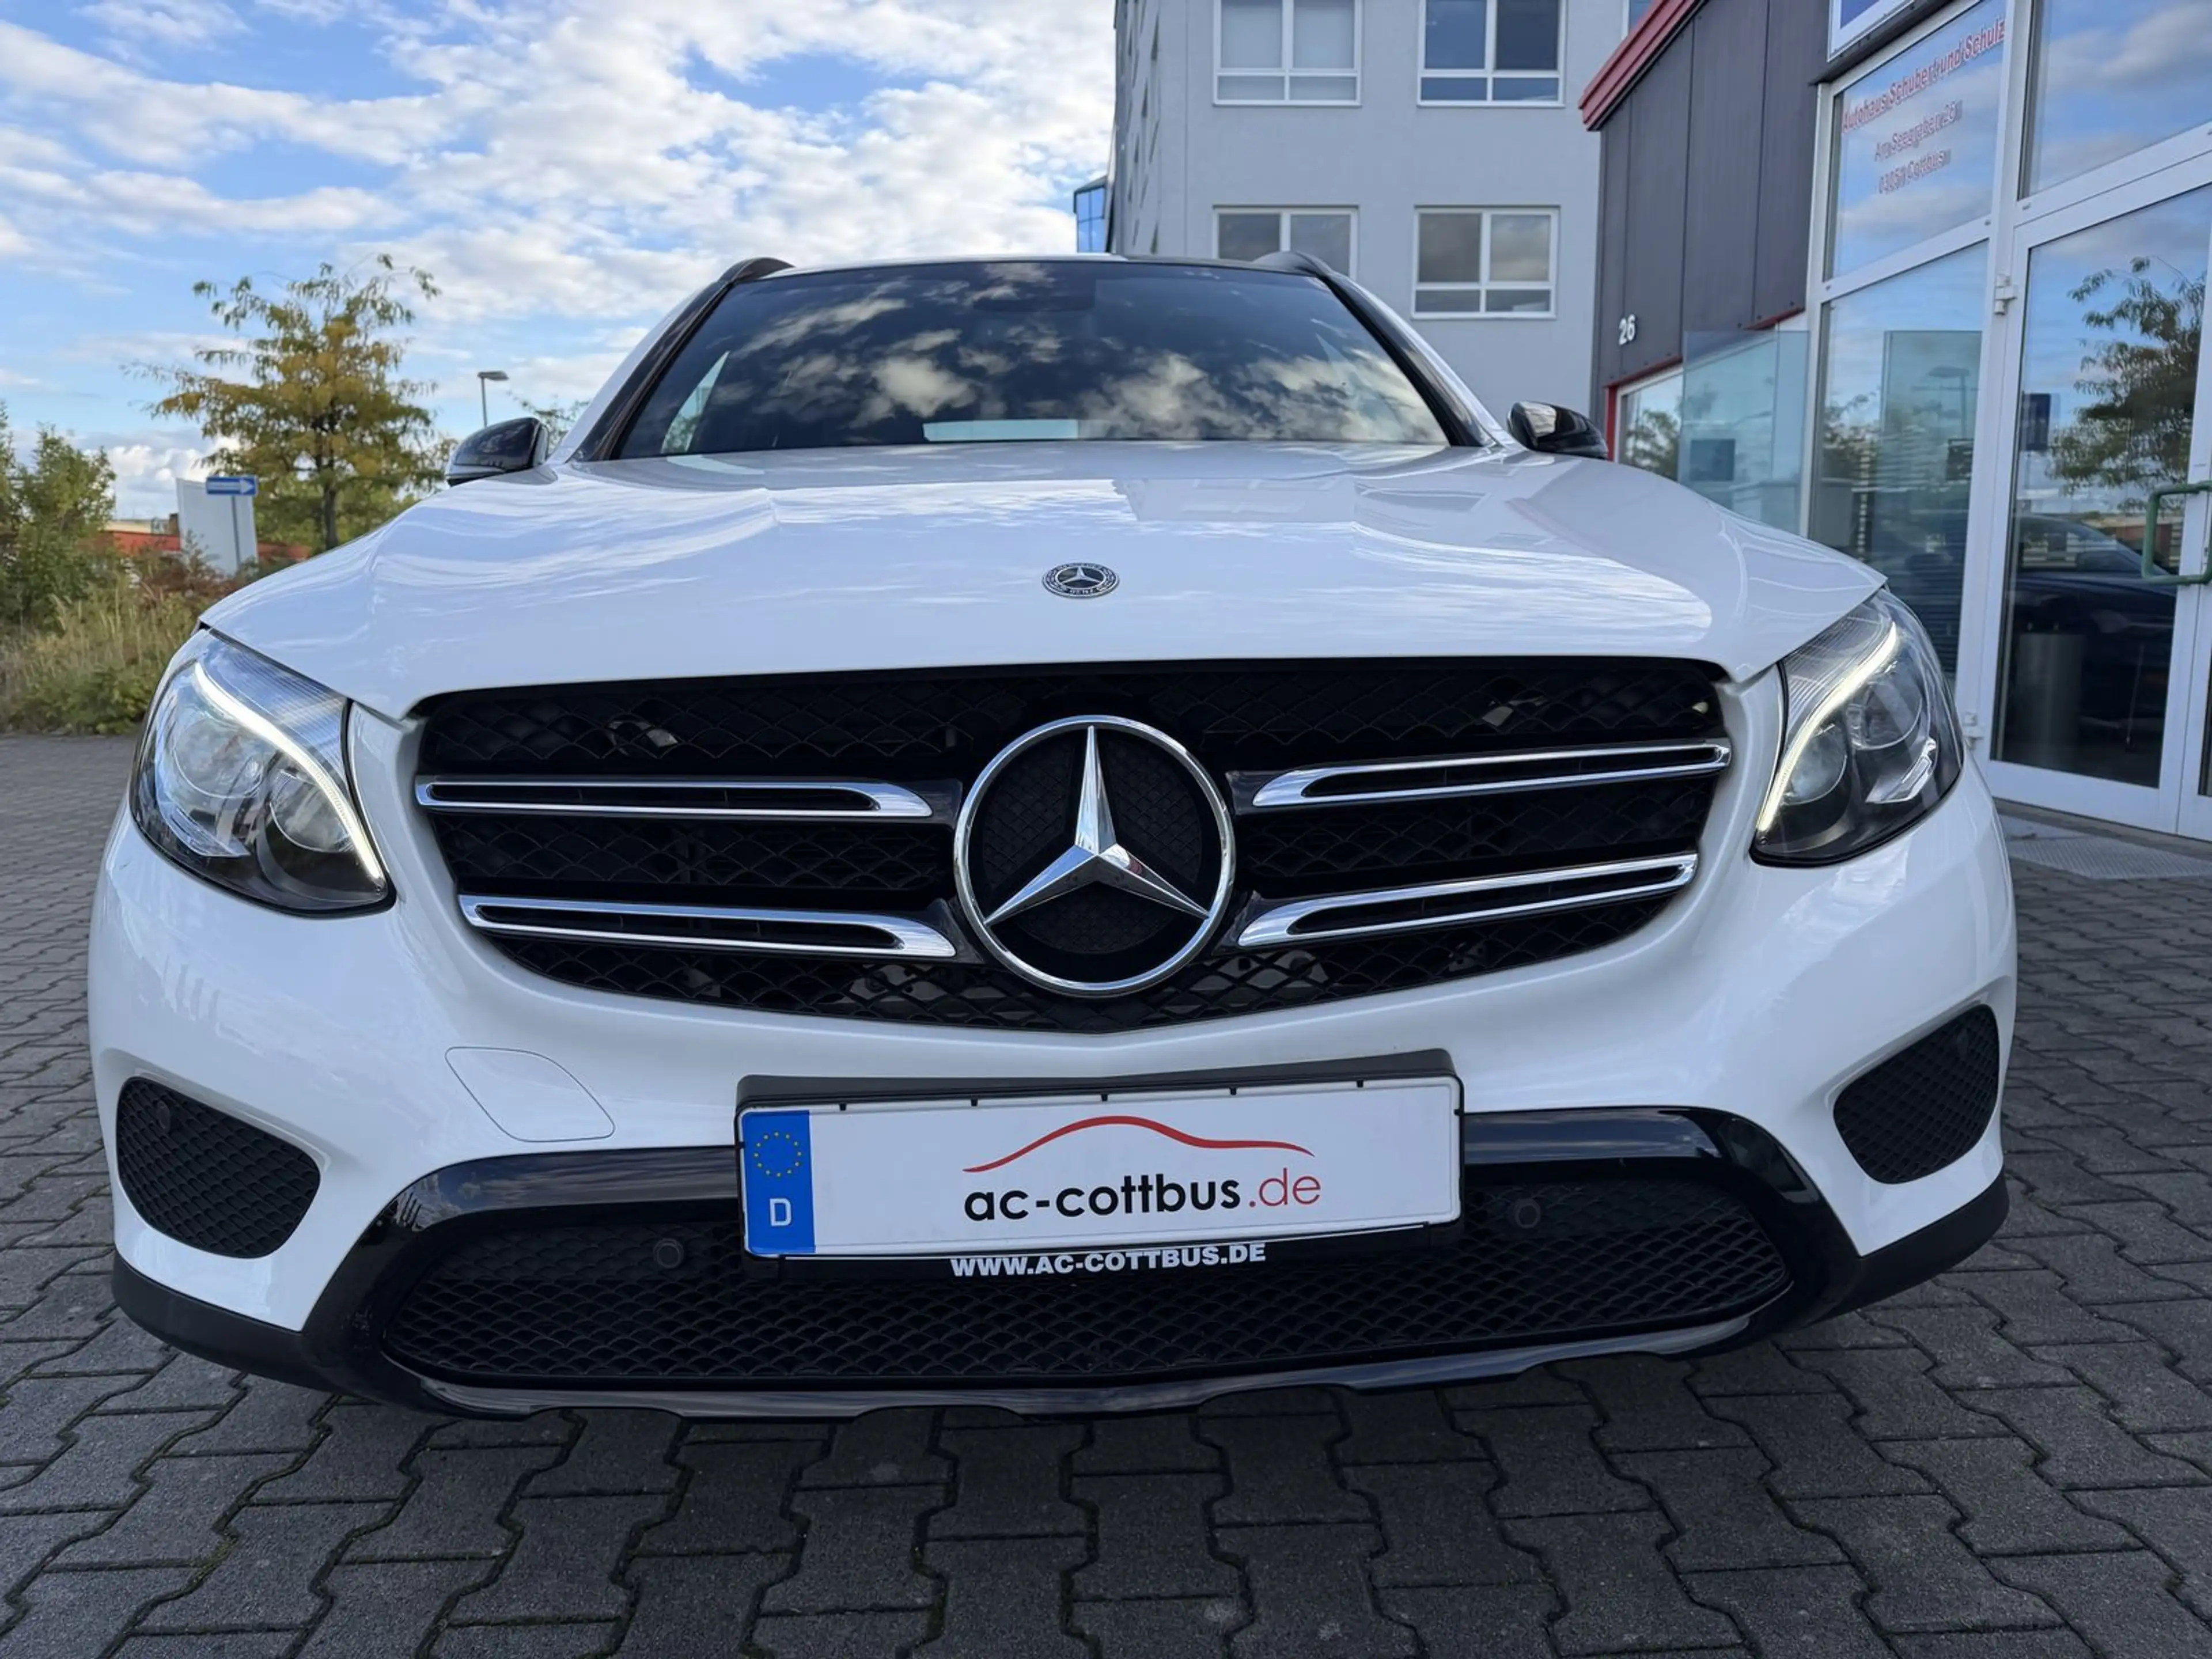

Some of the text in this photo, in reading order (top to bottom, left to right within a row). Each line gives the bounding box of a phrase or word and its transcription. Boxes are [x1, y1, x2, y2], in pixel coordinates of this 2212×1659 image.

[1619, 314, 1635, 345] 26
[964, 1168, 1321, 1221] ac-cottbus.de
[769, 1198, 792, 1226] D
[950, 1243, 1266, 1277] WWW.AC-COTTBUS.DE
